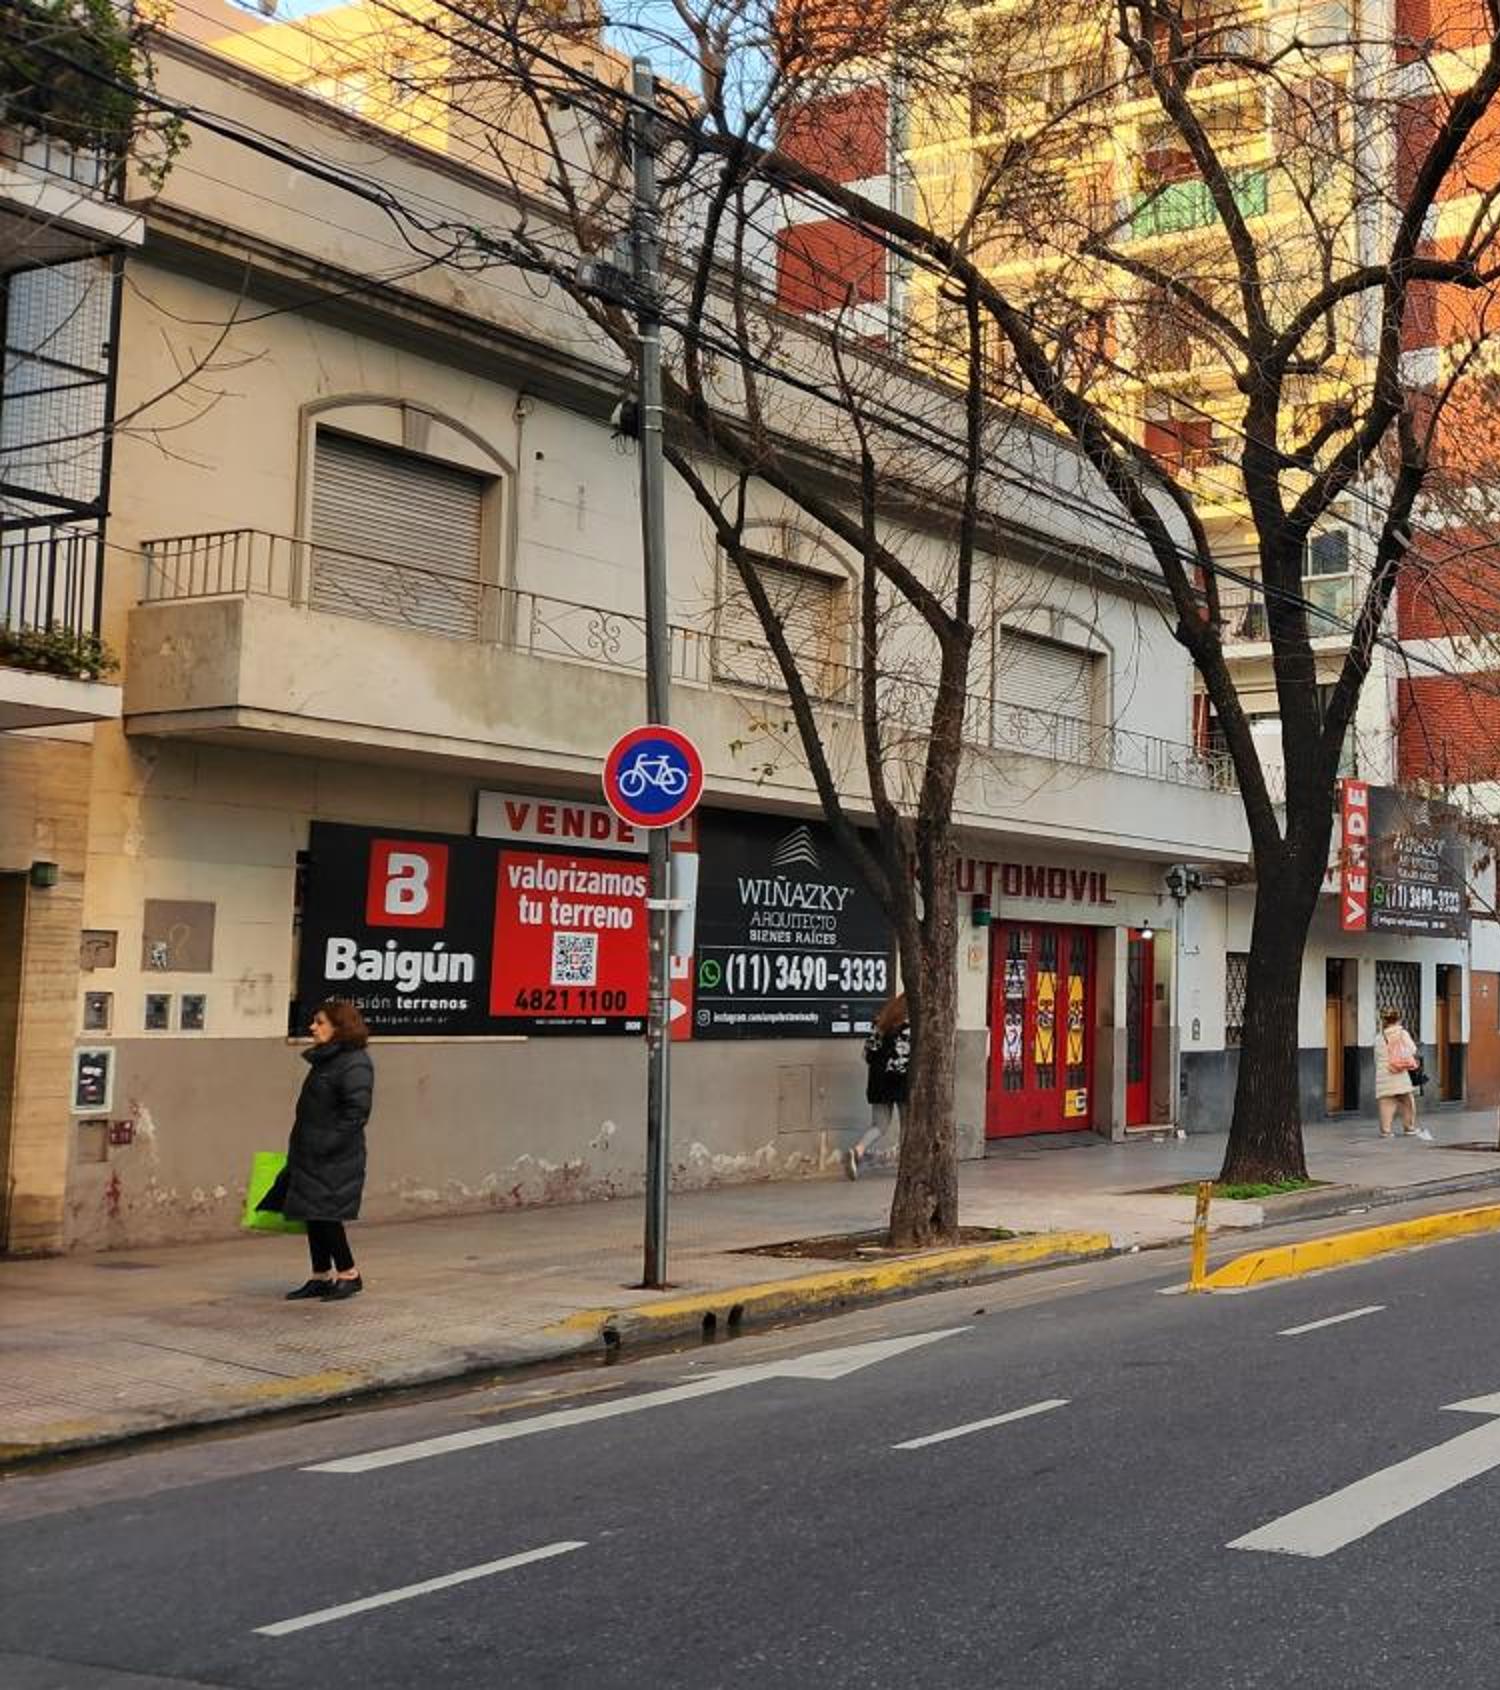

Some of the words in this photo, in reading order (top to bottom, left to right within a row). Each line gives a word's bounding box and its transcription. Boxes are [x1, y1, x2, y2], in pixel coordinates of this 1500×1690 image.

[505, 801, 636, 843] VENDE
[508, 859, 647, 896] valorizamos
[738, 876, 849, 911] WIÑAZKY
[956, 858, 1117, 904] UTOMOVIL
[518, 895, 543, 925] tu
[551, 896, 633, 929] terreno
[751, 911, 837, 931] ARQUITECTO
[750, 929, 791, 943] BIENES
[795, 930, 837, 945] RAÍCES
[325, 937, 475, 992] Baigún
[726, 953, 771, 994] (11)
[775, 955, 887, 992] 3490-3333
[397, 996, 468, 1010] terrenos
[515, 989, 569, 1011] 4821
[578, 990, 627, 1011] 1100
